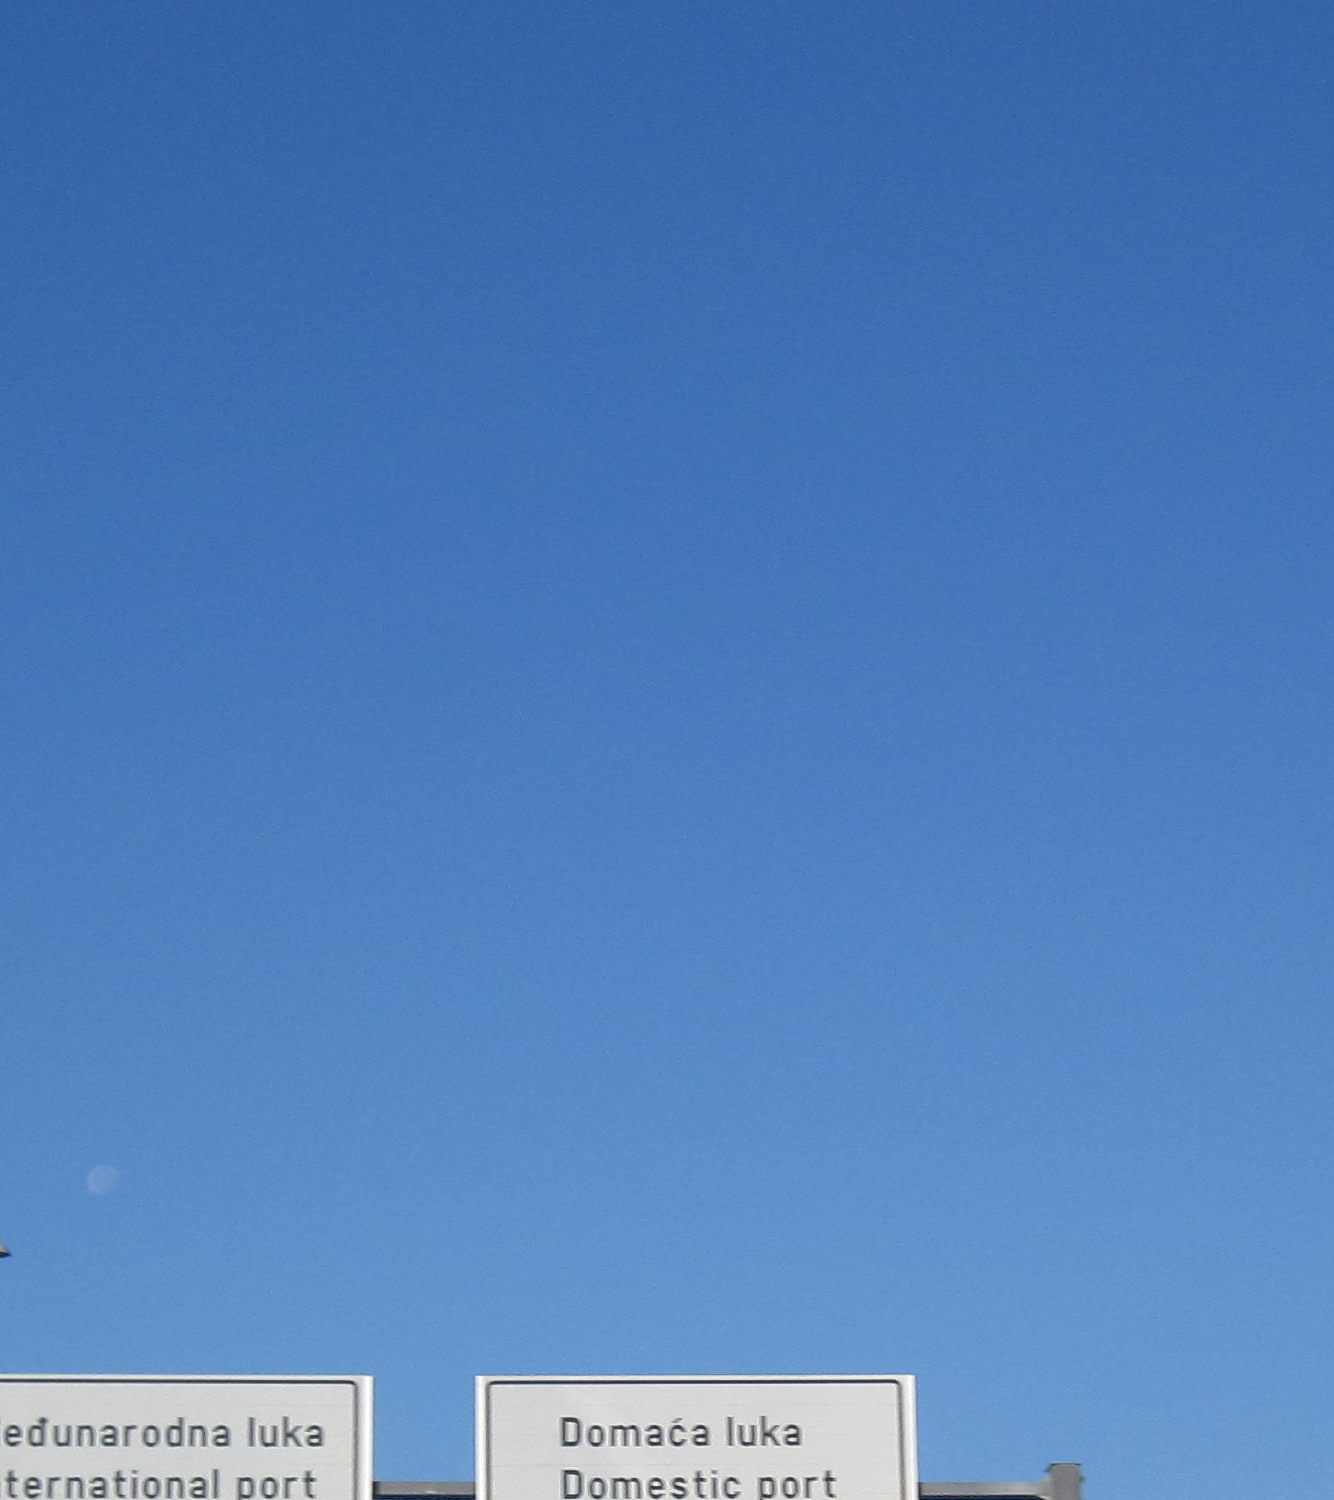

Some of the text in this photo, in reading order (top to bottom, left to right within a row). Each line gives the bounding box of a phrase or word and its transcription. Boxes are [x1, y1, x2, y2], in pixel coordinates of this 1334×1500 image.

[247, 1414, 326, 1448] luka
[559, 1414, 803, 1449] Domaća luka
[560, 1468, 742, 1500] Domestic
